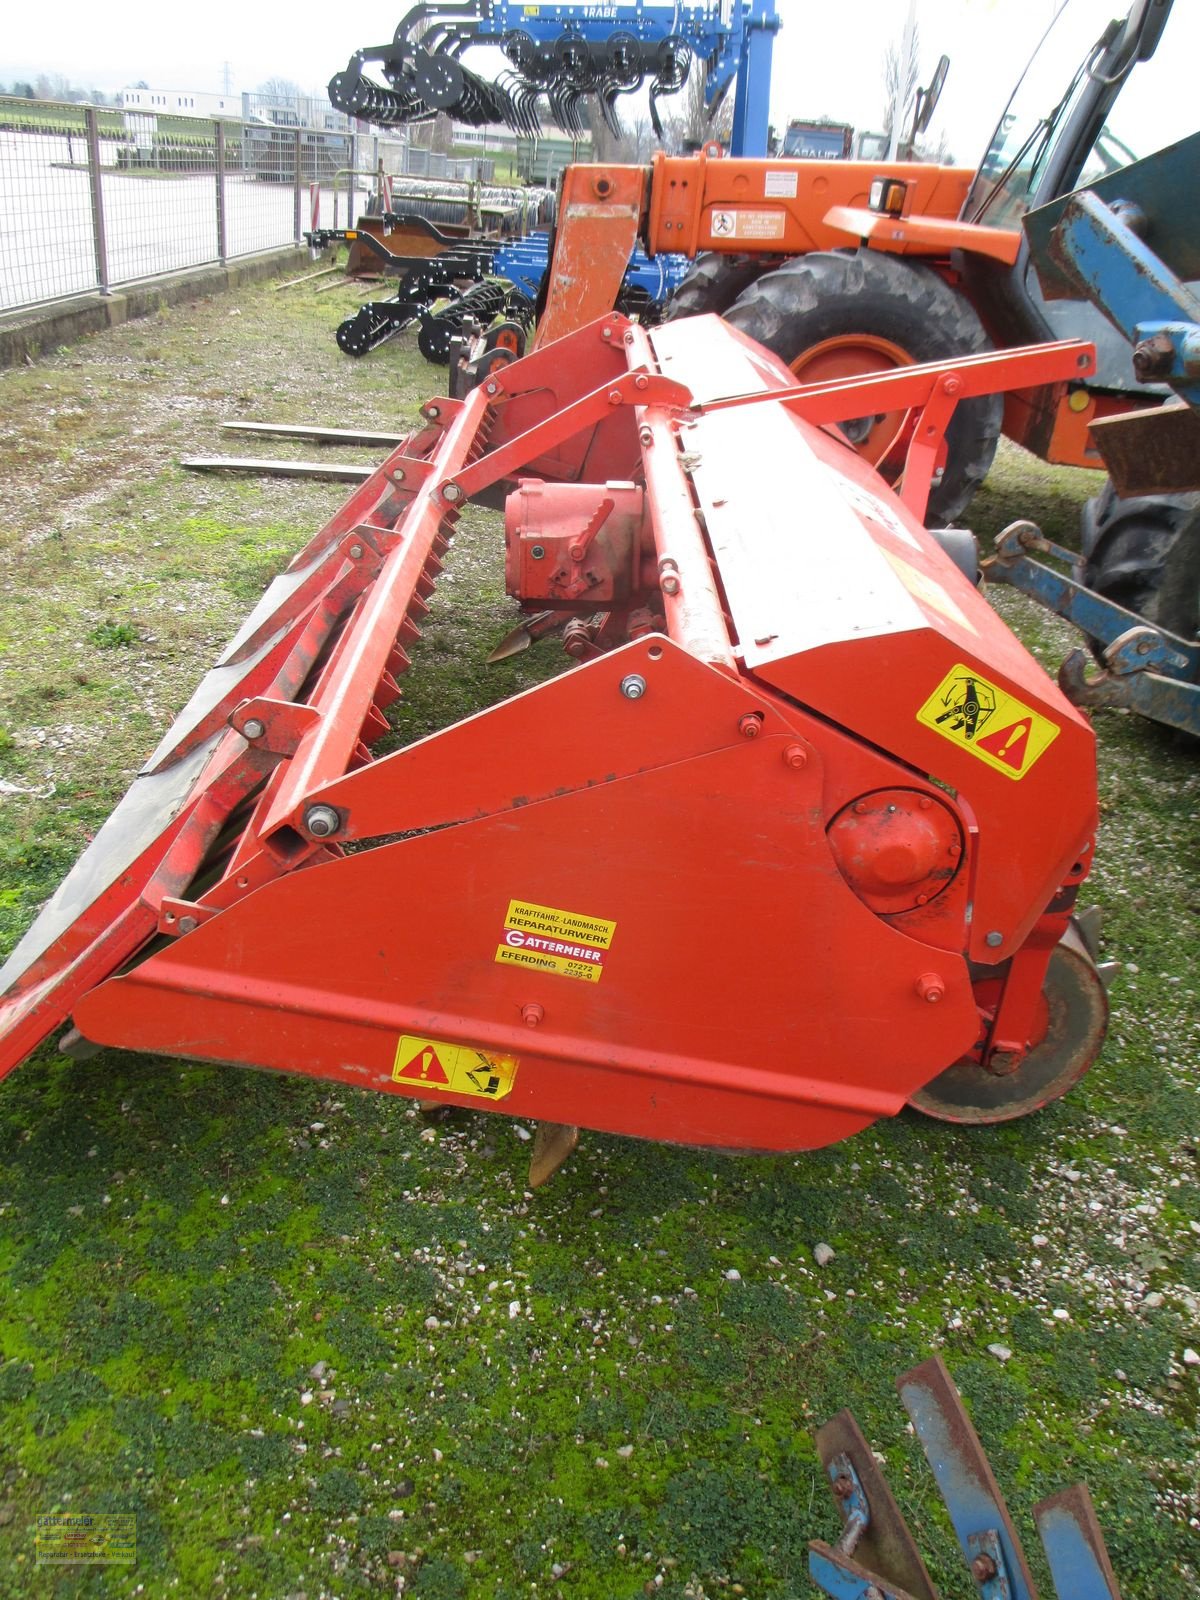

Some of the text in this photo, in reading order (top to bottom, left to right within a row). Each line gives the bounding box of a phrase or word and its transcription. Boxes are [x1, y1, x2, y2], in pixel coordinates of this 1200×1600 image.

[589, 7, 618, 18] RABE
[509, 917, 608, 944] REPARATURWERK
[506, 930, 601, 961] GATTERMEIER
[501, 950, 593, 972] EFERDING 07272
[563, 969, 592, 979] 2235-0
